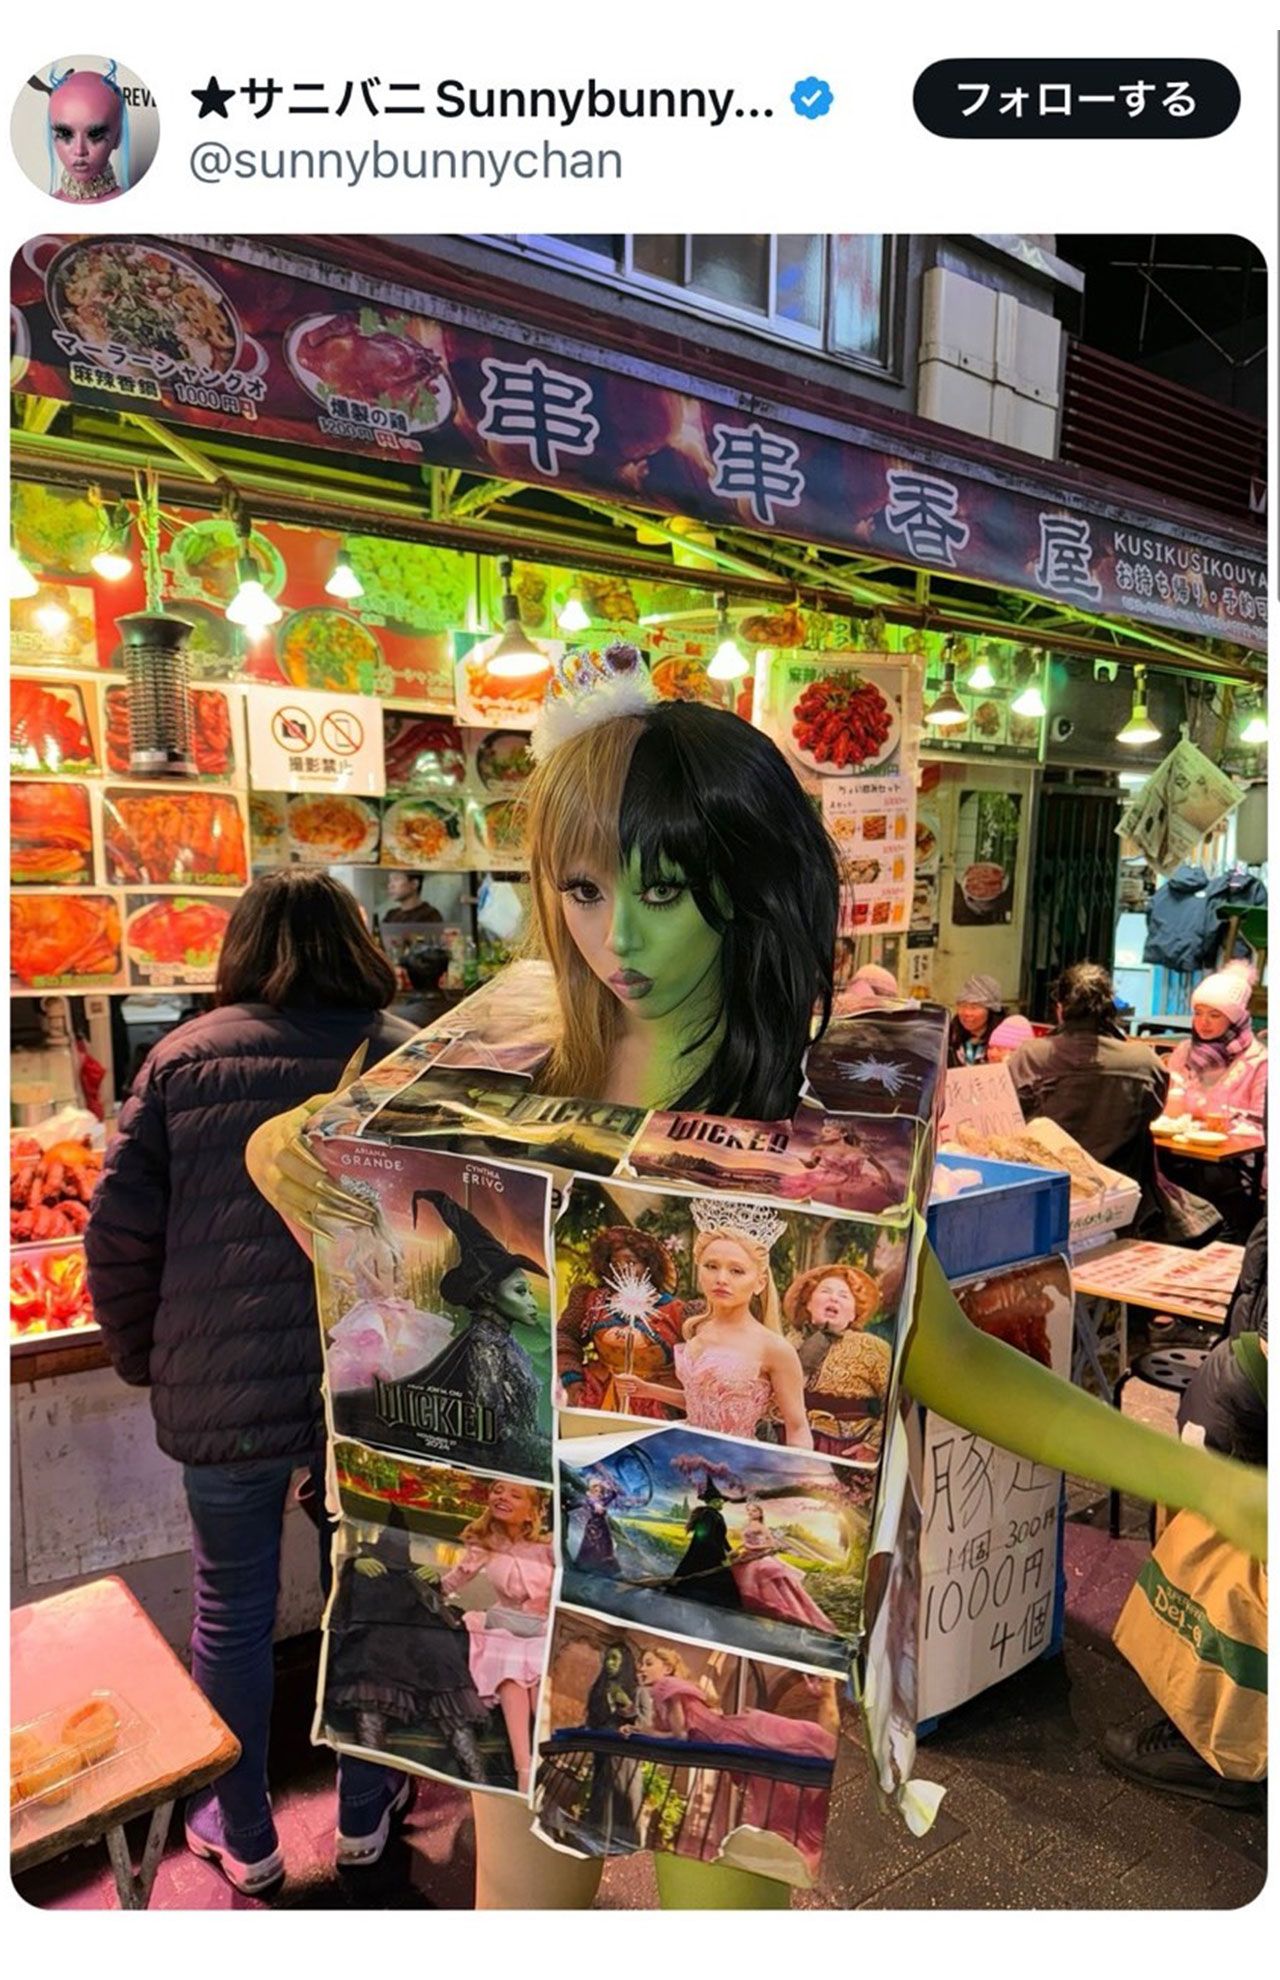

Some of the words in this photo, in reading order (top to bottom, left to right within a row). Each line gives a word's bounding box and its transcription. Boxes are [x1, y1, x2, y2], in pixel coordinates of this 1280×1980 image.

[52, 329, 267, 400] マーラーシャングオ
[1113, 531, 1268, 588] KUSIKUSIKOUYA
[288, 756, 355, 777] 撮影禁止
[354, 1147, 388, 1158] ARIANA
[666, 1115, 790, 1154] WICKED
[341, 1154, 404, 1172] GRANDE
[462, 1171, 505, 1193] ERIVO
[465, 1163, 501, 1180] CYNTHIA
[374, 1374, 498, 1445] WICKED
[946, 1530, 992, 1576] 1個
[924, 1548, 1045, 1641] 1000円
[990, 1589, 1052, 1669] 4個
